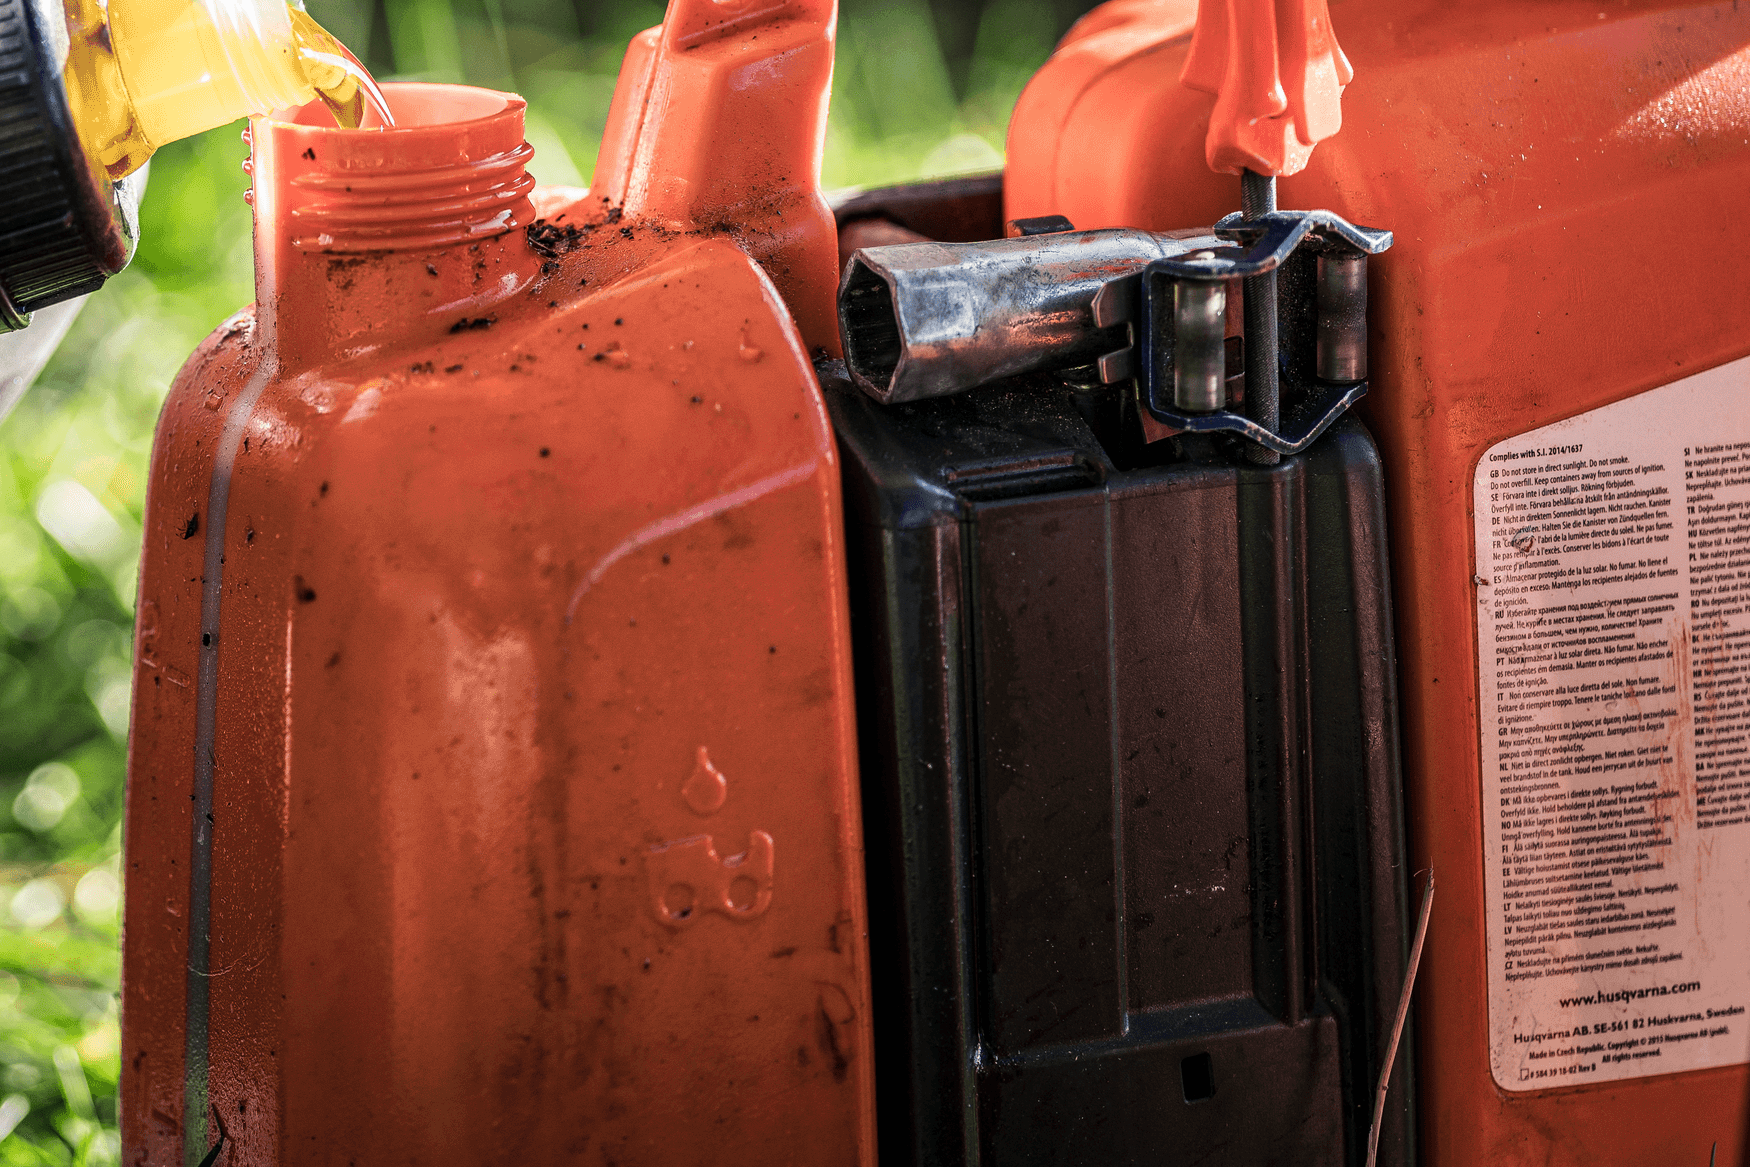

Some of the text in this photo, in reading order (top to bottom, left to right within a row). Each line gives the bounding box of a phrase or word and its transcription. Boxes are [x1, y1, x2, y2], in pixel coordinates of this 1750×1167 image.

[1489, 444, 1583, 462] Complies with S.I. 2014/1637
[1490, 470, 1499, 478] GB
[1502, 469, 1510, 477] Do
[1511, 468, 1521, 476] not
[1522, 467, 1537, 475] store
[1545, 464, 1562, 472] direct
[1563, 460, 1588, 471] sunlight.
[1589, 459, 1597, 468] Do
[1598, 458, 1608, 466] not
[1609, 456, 1629, 465] smoke.
[1491, 482, 1499, 490] Do
[1500, 481, 1510, 489] not
[1511, 478, 1533, 488] overfill.
[1534, 477, 1549, 486] Keep
[1550, 474, 1580, 484] containers
[1598, 470, 1611, 478] from
[1613, 468, 1633, 476] sources
[1642, 464, 1665, 475] ignition.
[1491, 503, 1514, 514] Överfyll
[1515, 503, 1528, 511] inte.
[1529, 501, 1551, 509] Förvara
[1585, 494, 1602, 503] åtskilt
[1603, 492, 1615, 501] från
[1616, 486, 1669, 500] antändningskällor.
[1502, 492, 1524, 501] Förvara
[1541, 487, 1558, 496] direkt
[1559, 485, 1579, 495] solljus.
[1581, 483, 1605, 492] Rökning
[1605, 479, 1635, 489] förbjuden.
[1492, 517, 1500, 525] DE
[1504, 515, 1518, 524] Nicht
[1526, 512, 1552, 522] direktem
[1553, 508, 1586, 519] Sonnenlicht
[1587, 507, 1607, 516] lagern.
[1608, 503, 1622, 512] Nicht
[1624, 501, 1648, 510] rauchen.
[1649, 499, 1671, 507] Kanister
[1492, 528, 1507, 537] nicht
[1542, 523, 1561, 531] Halten
[1562, 521, 1571, 530] Sie
[1572, 520, 1581, 528] die
[1583, 518, 1606, 527] Kanister
[1619, 512, 1655, 523] Zündquellen
[1655, 510, 1669, 518] fern.
[1493, 540, 1501, 549] FR
[1538, 535, 1552, 544] l'abri
[1568, 531, 1590, 541] lumière
[1591, 529, 1610, 538] directe
[1619, 525, 1635, 535] soleil.
[1645, 525, 1655, 533] pas
[1656, 522, 1673, 530] fumer.
[1493, 552, 1501, 560] Ne
[1502, 553, 1512, 561] pas
[1541, 546, 1562, 555] l'excès.
[1562, 544, 1591, 553] Conserver
[1592, 542, 1601, 550] les
[1601, 540, 1621, 549] bidons
[1627, 537, 1645, 545] l'écart
[1654, 534, 1669, 542] toute
[1538, 569, 1567, 581] protegido
[1583, 566, 1592, 574] luz
[1593, 564, 1608, 573] solar.
[1618, 561, 1636, 570] fumar.
[1647, 558, 1661, 566] llene
[1494, 586, 1520, 597] depósito
[1551, 580, 1581, 589] Mantenga
[1582, 578, 1591, 586] los
[1592, 575, 1623, 586] recipientes
[1624, 571, 1648, 582] alejados
[1657, 569, 1678, 577] fuentes
[1503, 597, 1528, 609] ignición.
[1559, 981, 1700, 1008] www.husqvarna.com
[1514, 1030, 1570, 1044] Husqvarna
[1572, 1025, 1592, 1037] AB.
[1594, 1020, 1628, 1034] SE-561
[1633, 1018, 1644, 1029] 82
[1706, 1006, 1745, 1019] Sweden
[1529, 1051, 1547, 1060] Made
[1556, 1046, 1575, 1056] Czech
[1602, 1054, 1611, 1063] All
